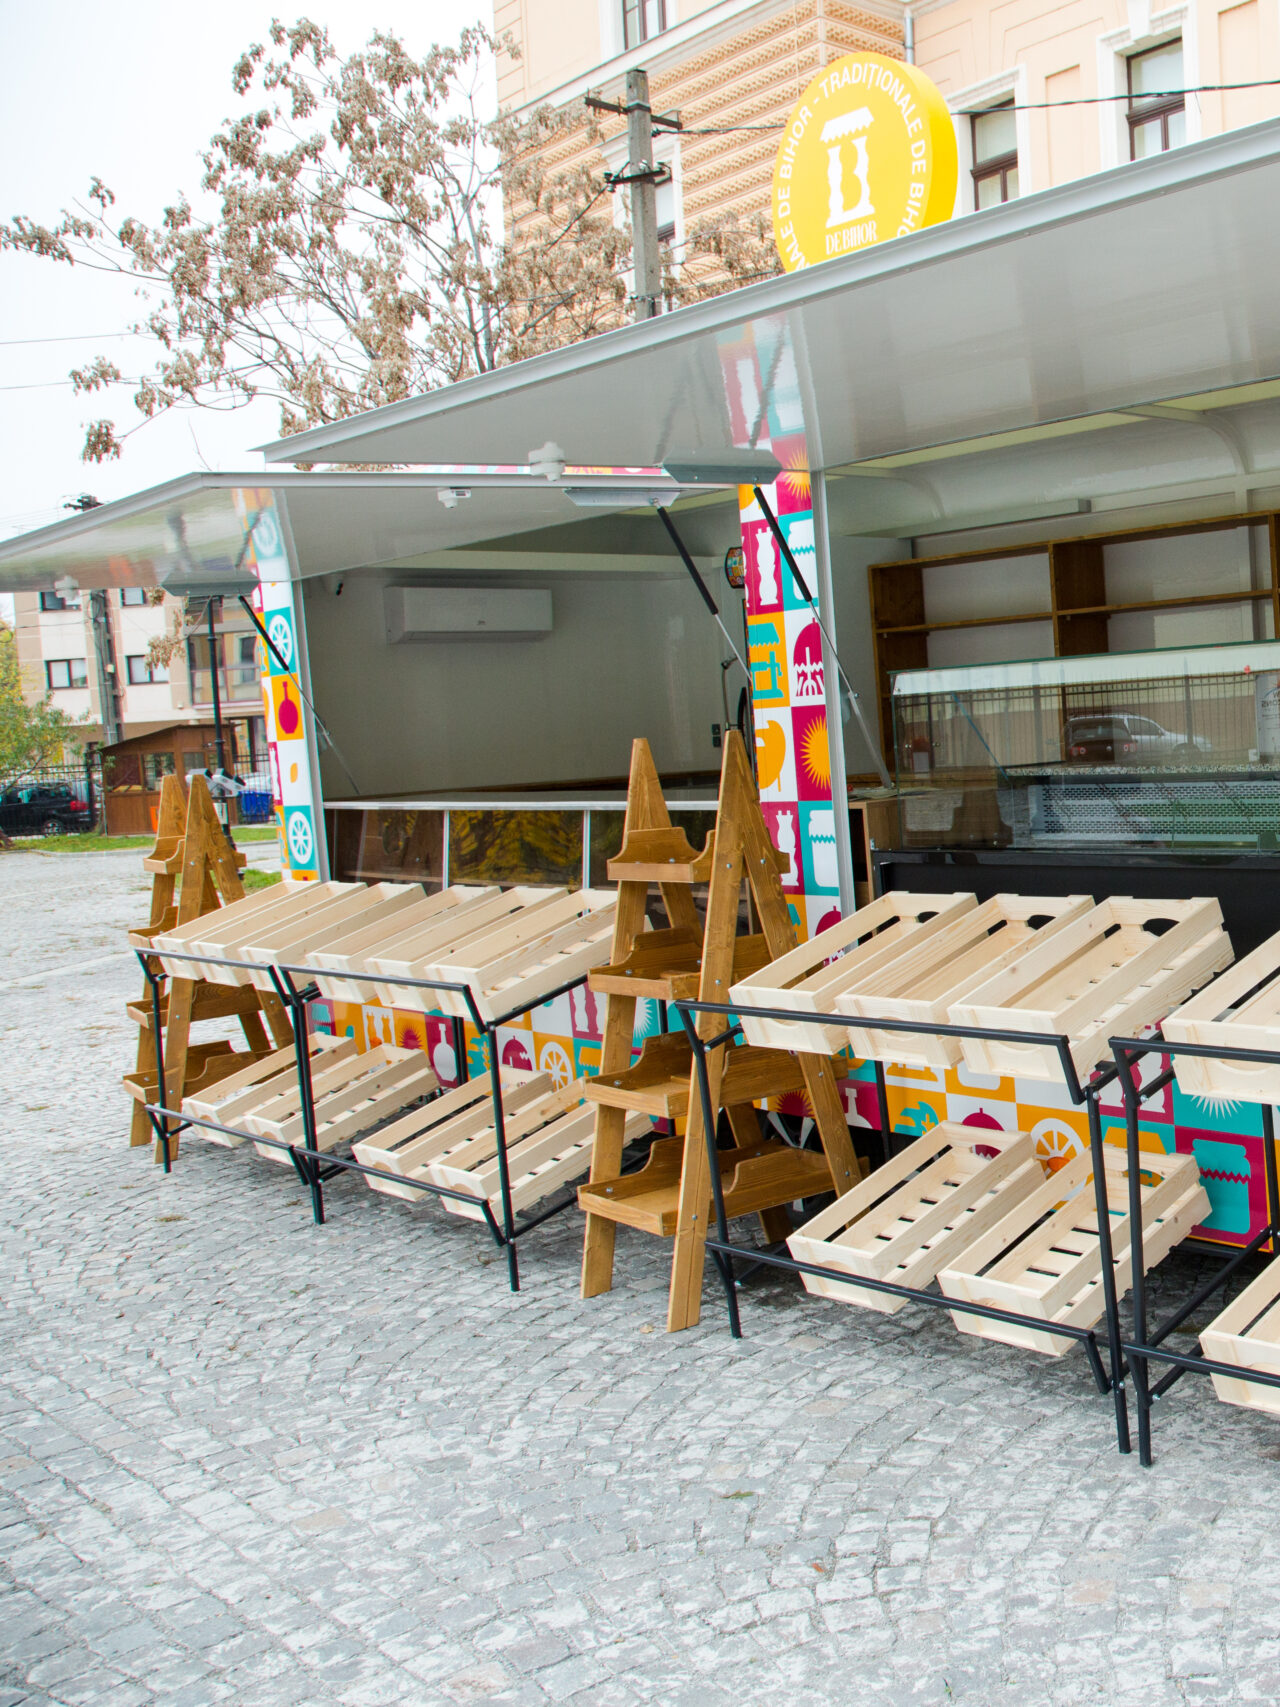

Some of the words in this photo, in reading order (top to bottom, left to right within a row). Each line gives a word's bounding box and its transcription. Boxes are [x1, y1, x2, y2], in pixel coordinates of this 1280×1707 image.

[779, 105, 813, 179] BIHOR
[910, 139, 926, 175] DE
[778, 186, 790, 218] DE
